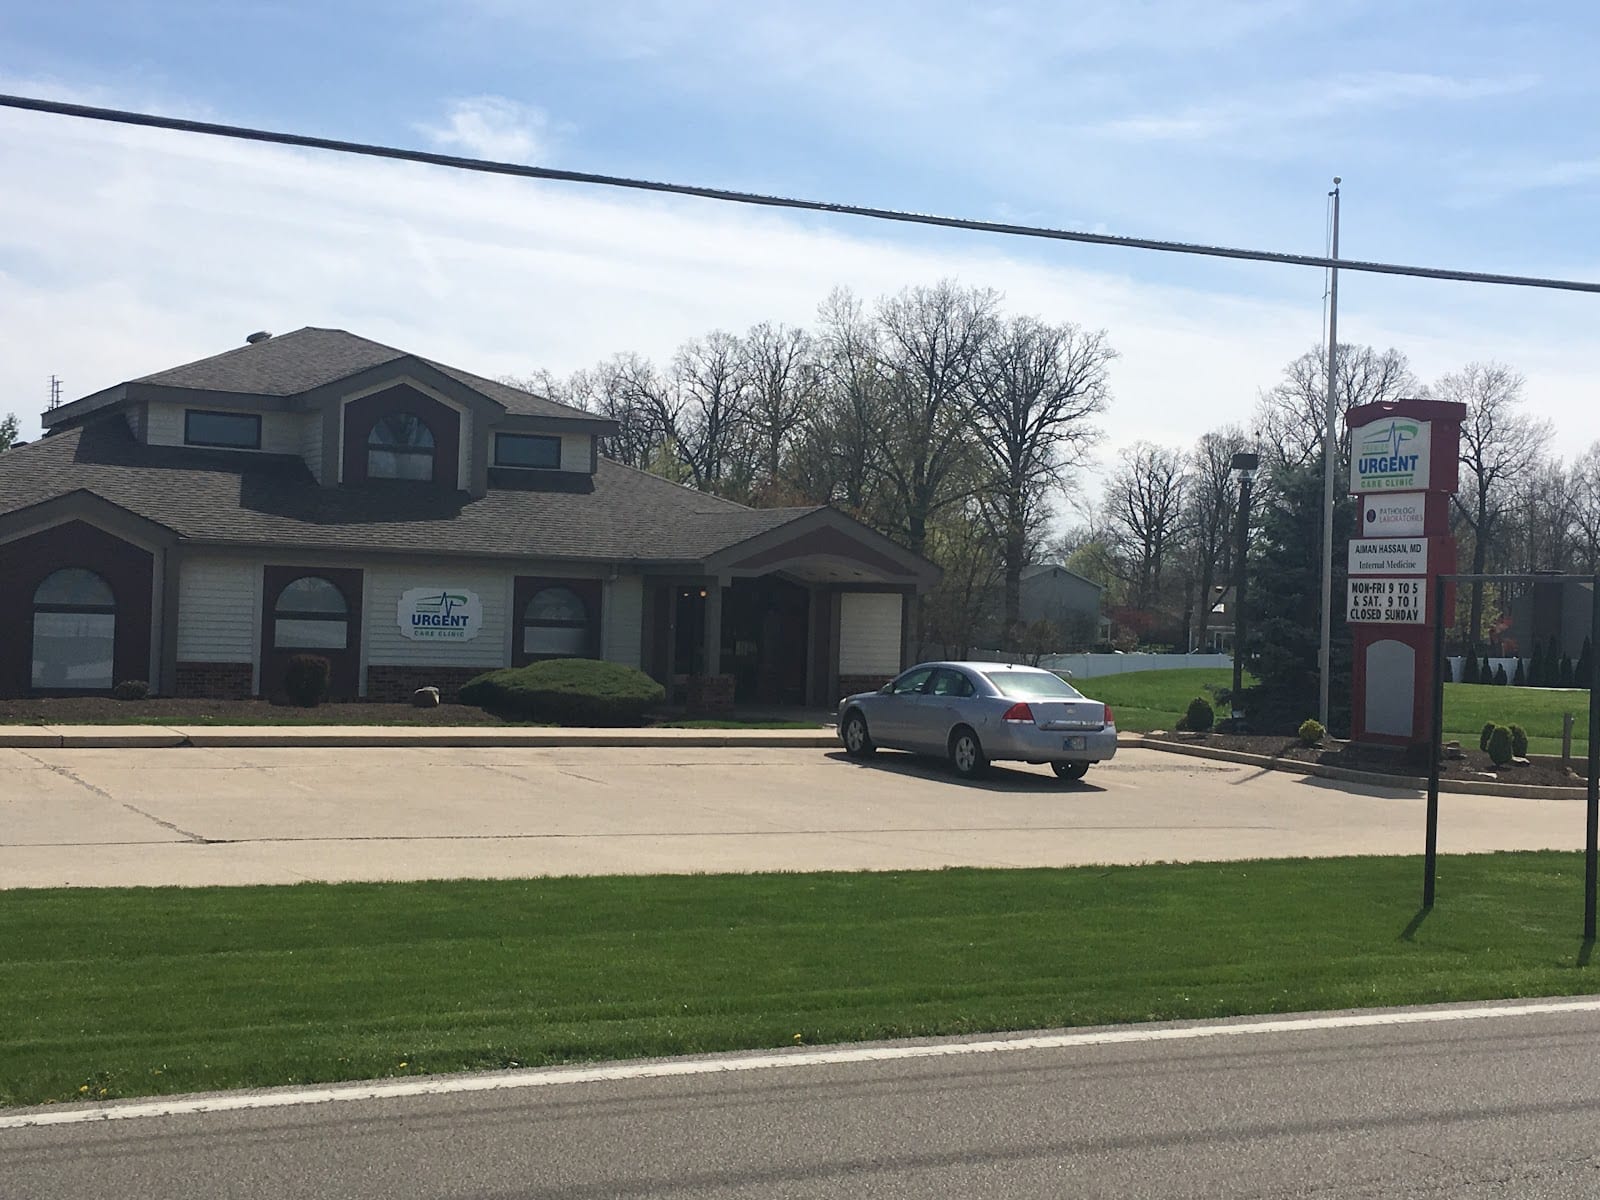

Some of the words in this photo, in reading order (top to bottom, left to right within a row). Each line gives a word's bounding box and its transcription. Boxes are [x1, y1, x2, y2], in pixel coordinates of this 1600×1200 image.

[1359, 455, 1419, 473] URGENT
[1361, 480, 1382, 488] CARE
[1385, 478, 1414, 487] CLINIC
[1380, 507, 1416, 515] PATHOLOGY
[1380, 514, 1423, 523] LABORATORIES
[1355, 544, 1377, 553] AIMAN
[1379, 544, 1408, 554] HASSAN,
[1410, 544, 1422, 553] MD
[1360, 561, 1385, 569] Internal
[1386, 560, 1416, 569] Medicine
[1352, 583, 1385, 594] MON-FRI
[1389, 583, 1394, 593] 9
[1398, 583, 1410, 593] TO
[1412, 583, 1418, 594] 5
[1353, 595, 1359, 607] &
[1363, 596, 1382, 607] SAT.
[1388, 596, 1393, 607] 9
[1398, 596, 1409, 607] TO
[412, 614, 469, 626] URGENT
[1350, 609, 1382, 620] CLOSED
[1385, 609, 1418, 621] SUNDAY
